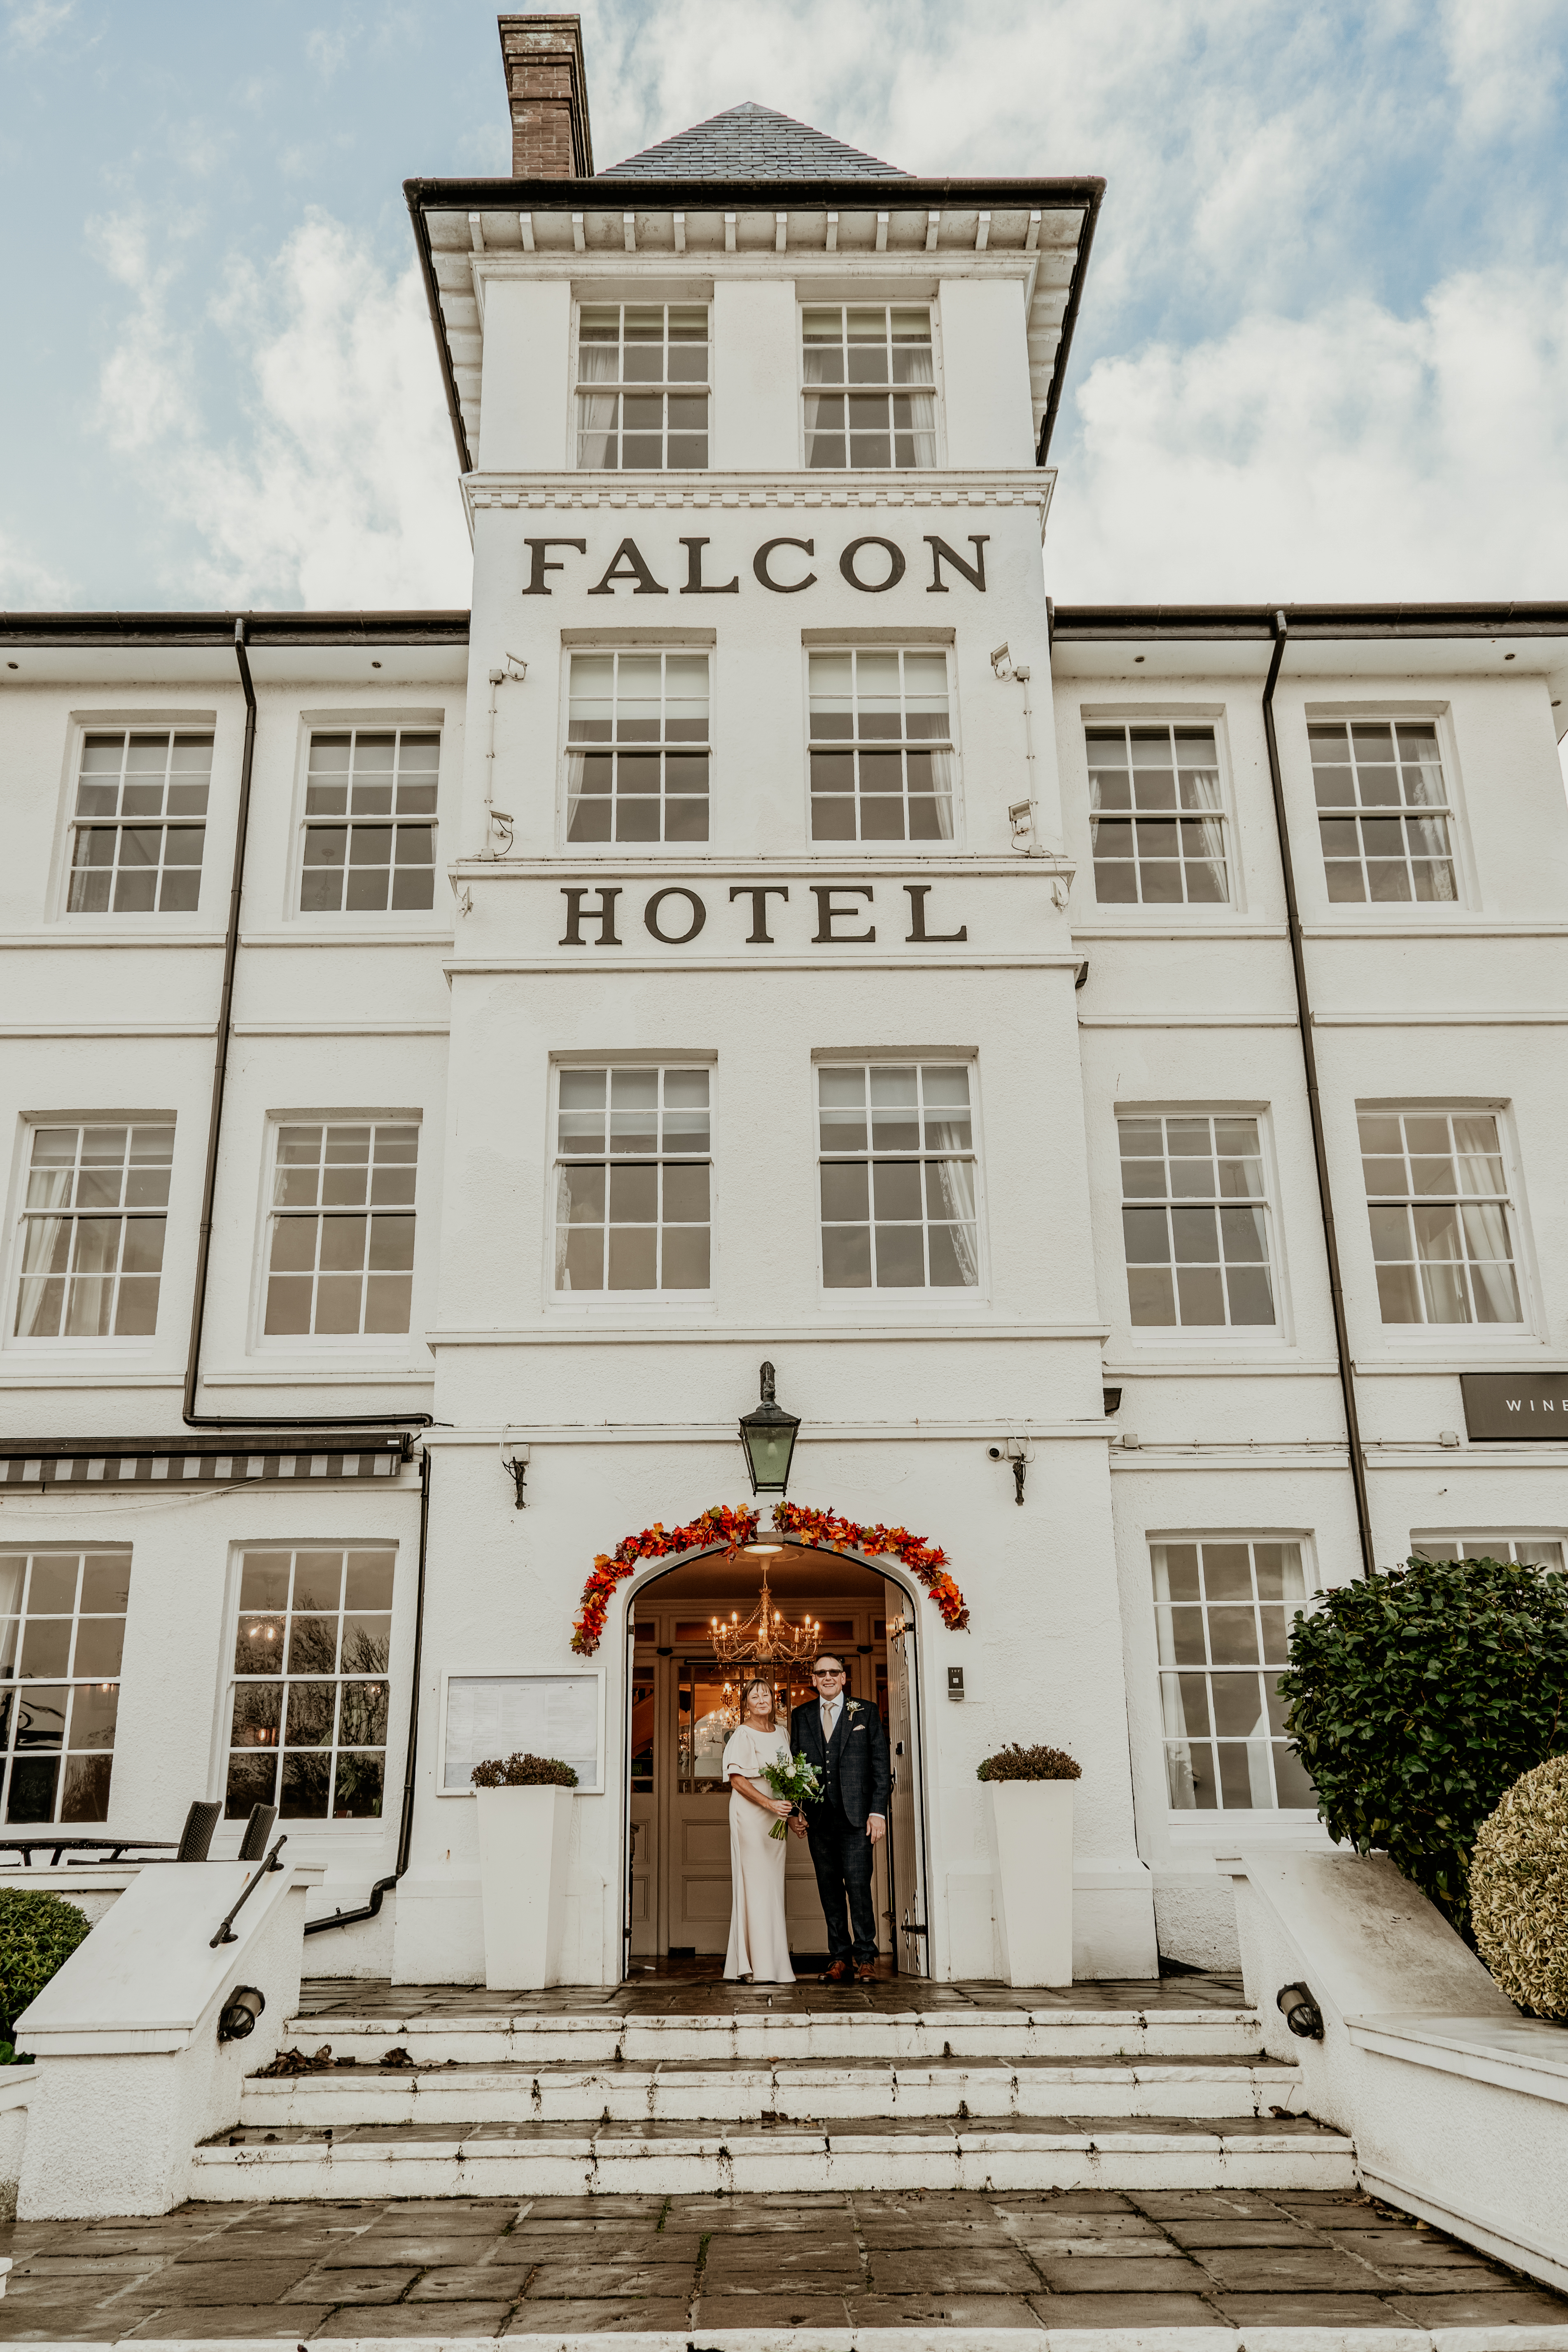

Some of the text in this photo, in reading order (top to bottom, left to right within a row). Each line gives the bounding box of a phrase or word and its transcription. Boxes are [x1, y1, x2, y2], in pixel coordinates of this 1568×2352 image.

[522, 535, 990, 595] FALCON
[558, 885, 968, 946] HOTEL
[1505, 1400, 1568, 1412] WINE
